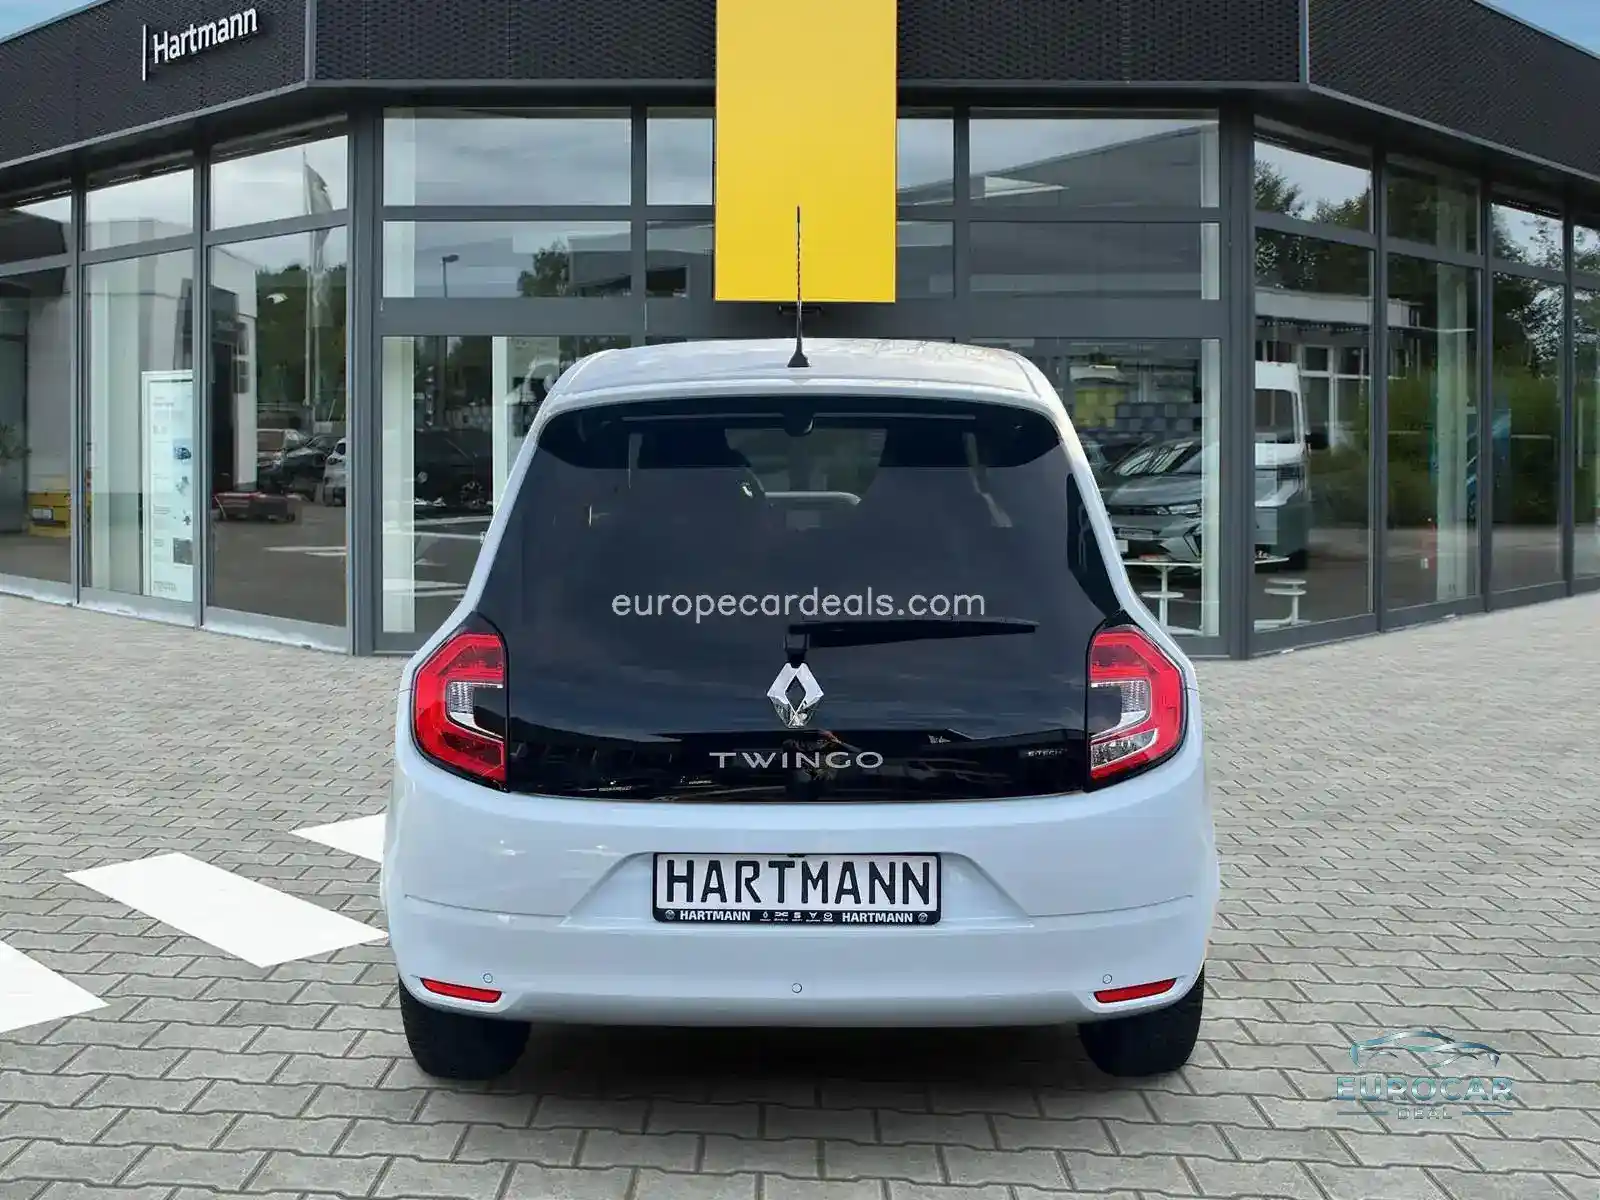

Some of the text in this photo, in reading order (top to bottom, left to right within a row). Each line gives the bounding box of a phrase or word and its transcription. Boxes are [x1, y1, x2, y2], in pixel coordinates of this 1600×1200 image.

[153, 8, 257, 64] Hartmann
[709, 751, 884, 769] TWINGO
[666, 860, 930, 905] HARTMANN
[679, 909, 751, 921] HARTMANN
[842, 912, 913, 923] HARTMANN
